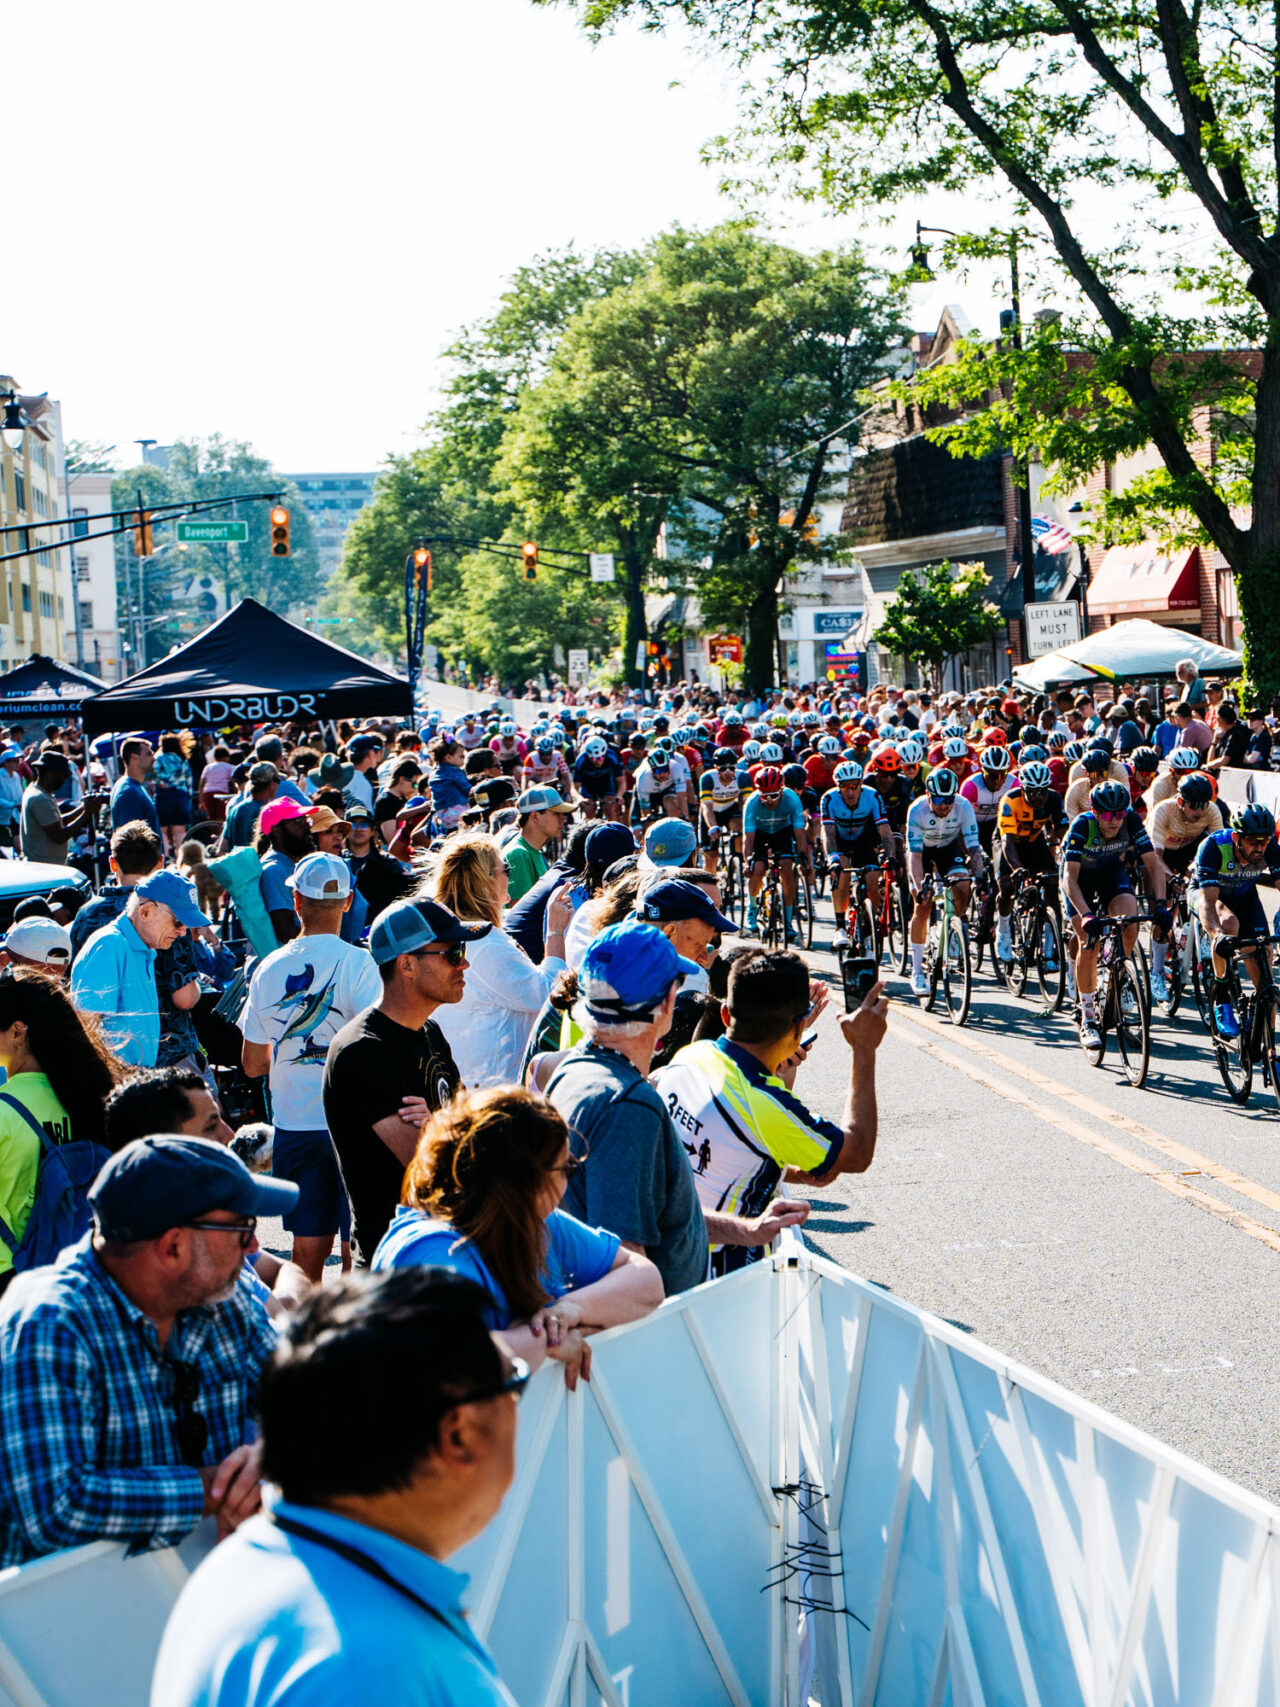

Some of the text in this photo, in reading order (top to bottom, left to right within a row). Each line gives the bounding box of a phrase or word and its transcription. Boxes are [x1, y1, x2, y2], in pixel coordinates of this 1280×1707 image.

[1031, 608, 1073, 619] LEFT LANE
[1040, 623, 1068, 634] MUST
[1033, 640, 1053, 650] TURN
[673, 1105, 704, 1137] FEET
